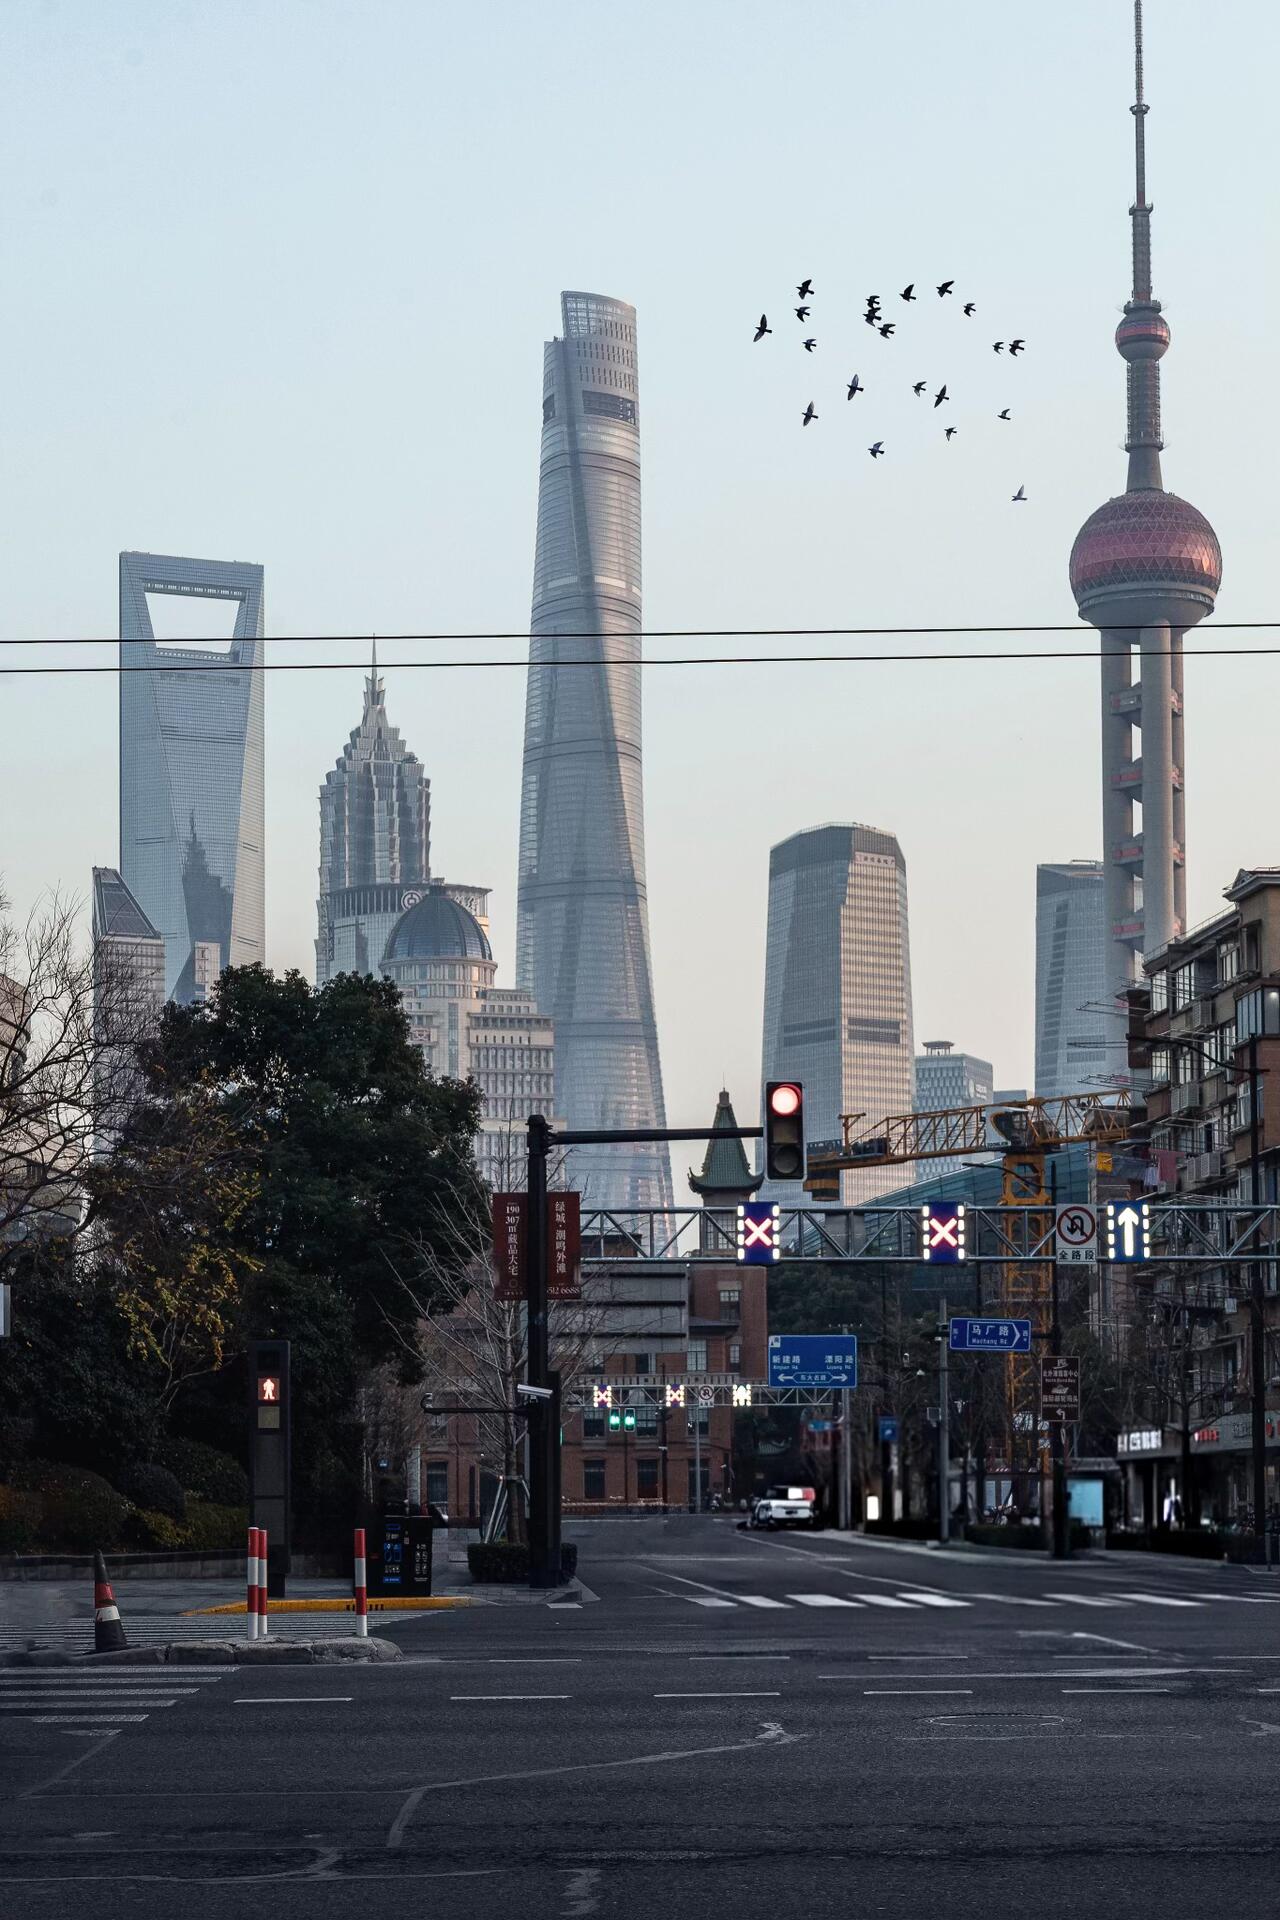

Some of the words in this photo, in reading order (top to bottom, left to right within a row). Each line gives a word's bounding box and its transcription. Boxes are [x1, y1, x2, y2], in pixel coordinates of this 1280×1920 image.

[506, 1206, 520, 1214] 190
[505, 1216, 520, 1225] 307
[1058, 1250, 1094, 1260] 全路段
[971, 1324, 1009, 1336] 马厂路
